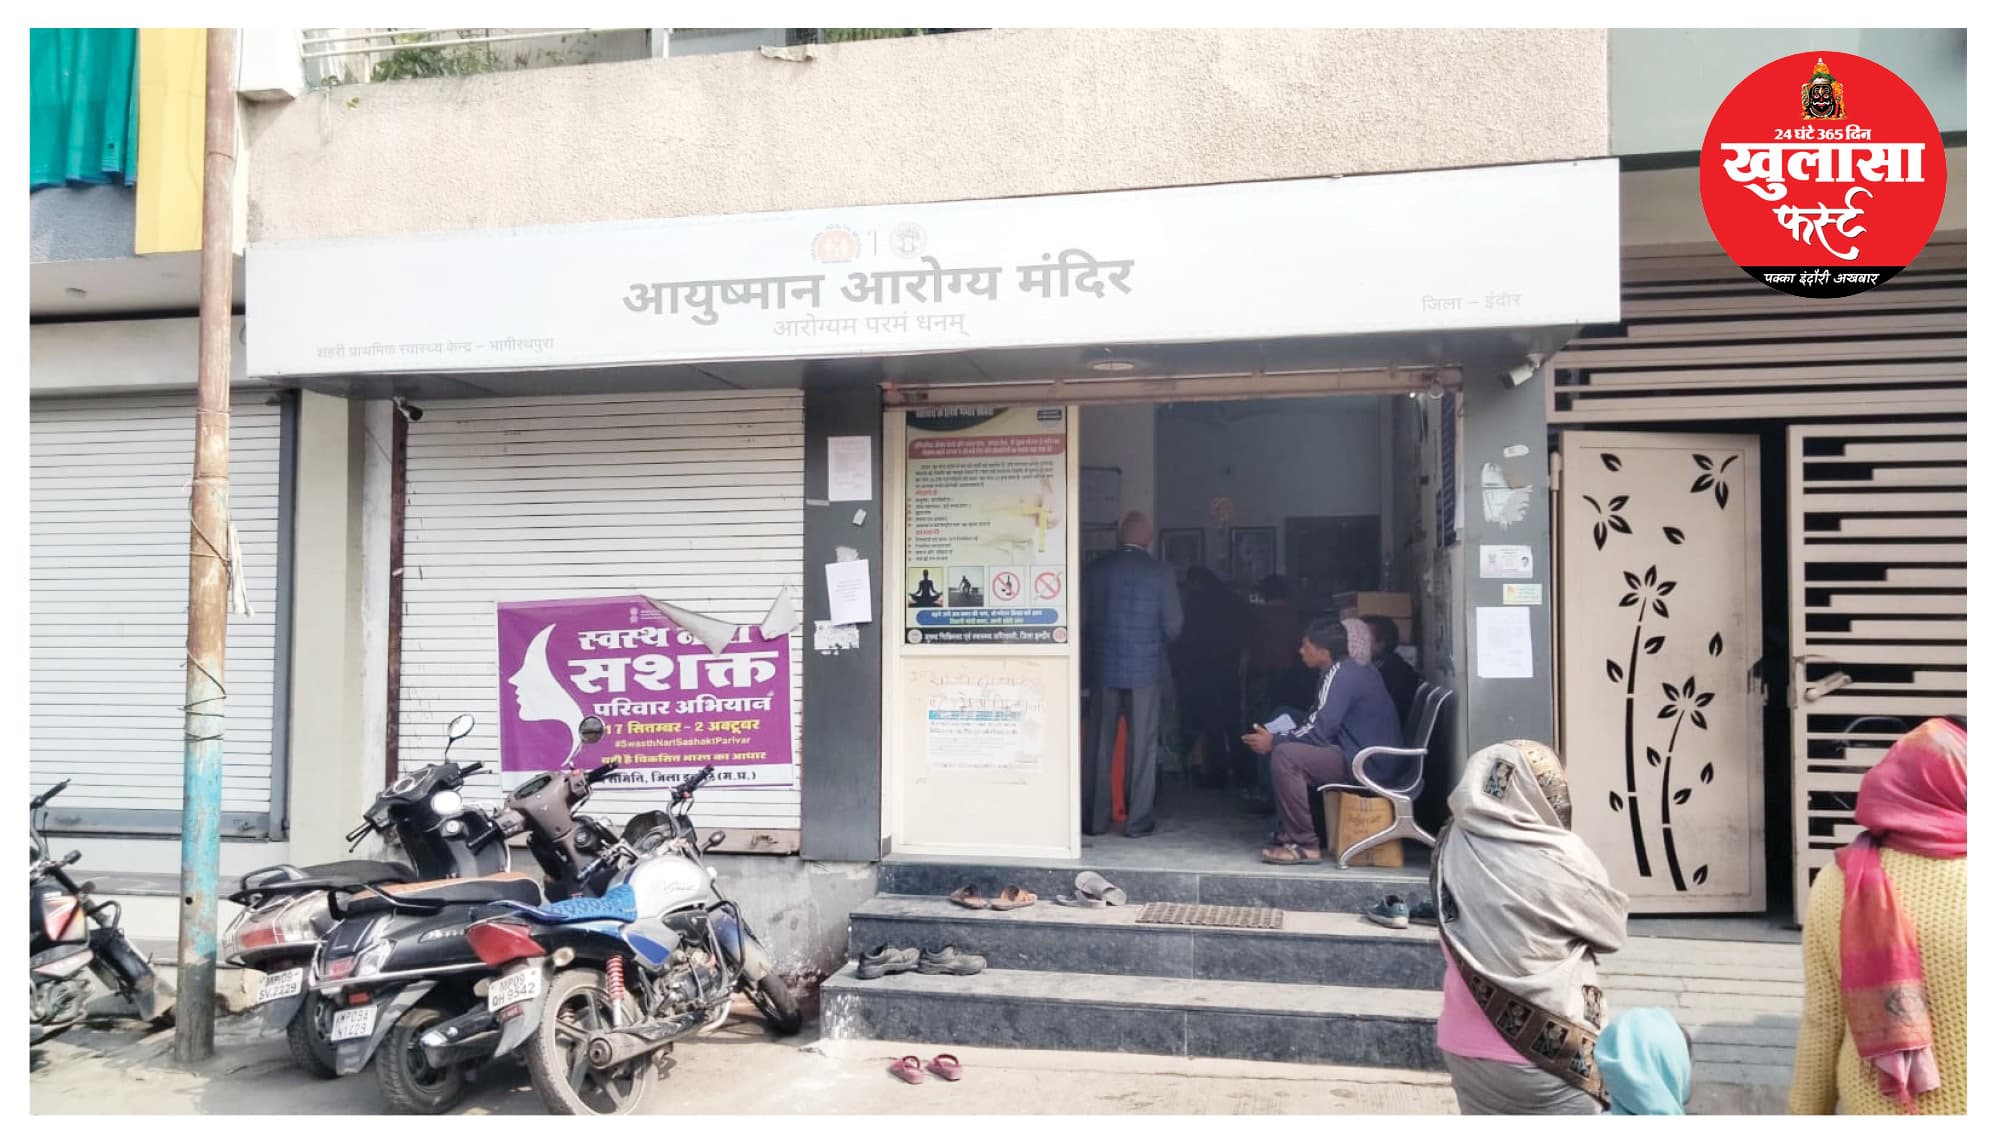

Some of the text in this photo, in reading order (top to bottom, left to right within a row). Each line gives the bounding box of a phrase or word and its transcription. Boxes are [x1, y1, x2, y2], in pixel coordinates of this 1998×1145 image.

[622, 248, 1135, 326] आयुष्मान आरोग्य मंदिर
[1419, 294, 1463, 312] जिला
[773, 310, 971, 338] आरोग्यम परमं धनम्
[577, 626, 670, 651] स्वस्थ
[567, 650, 779, 694] सशक्त
[593, 694, 773, 718] परिवार अभियान
[694, 722, 705, 732] 2
[499, 974, 525, 990] MP09
